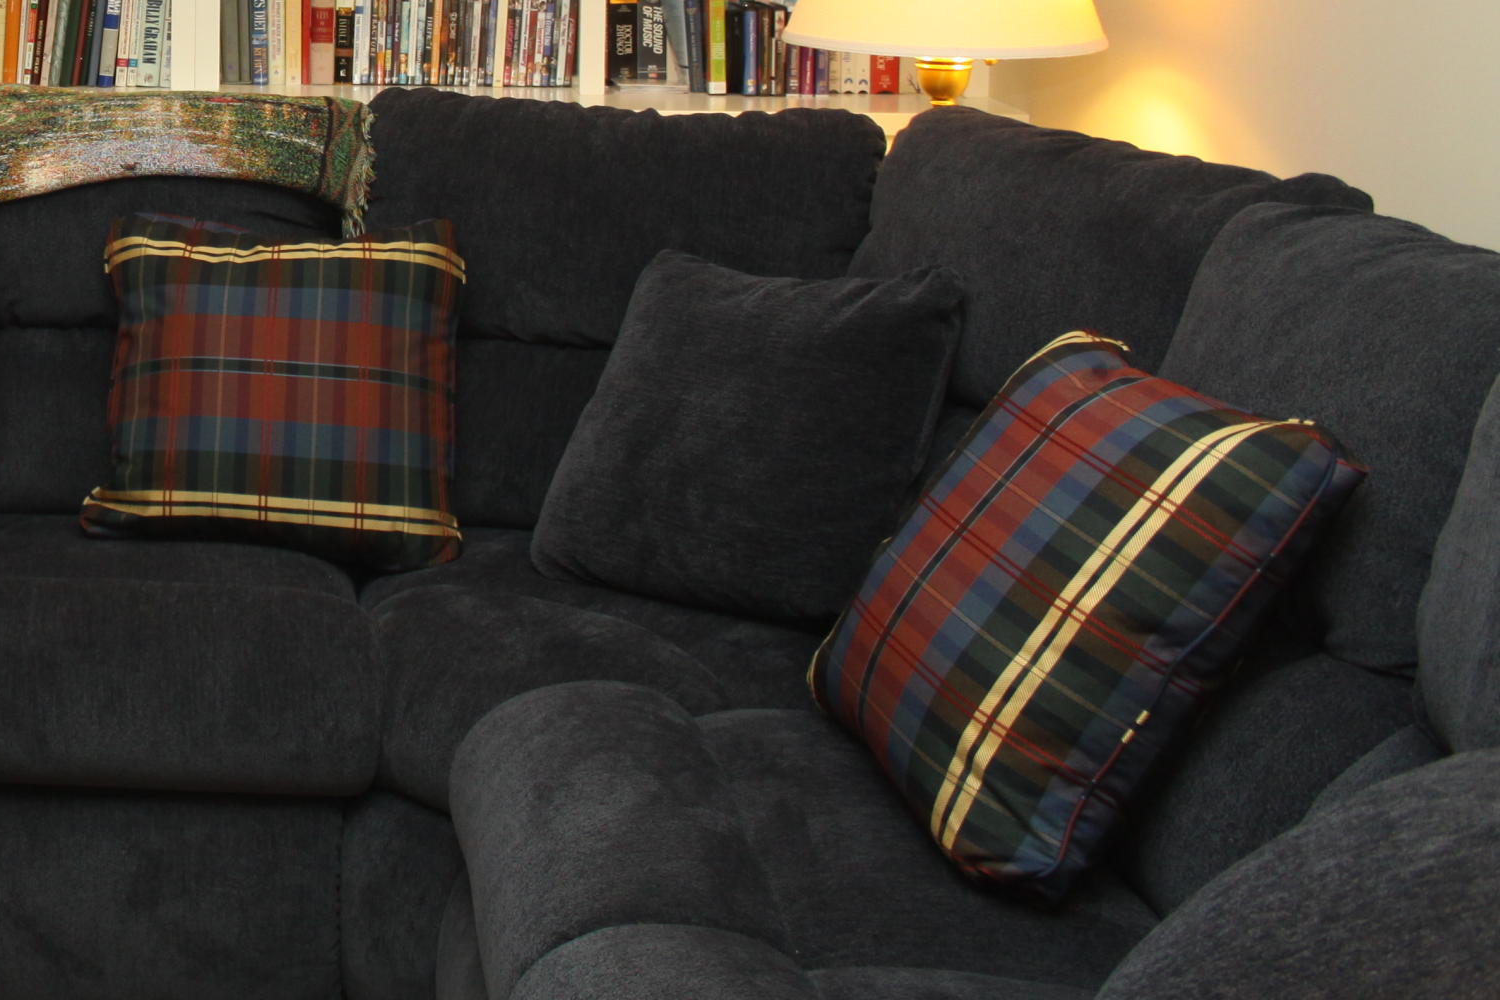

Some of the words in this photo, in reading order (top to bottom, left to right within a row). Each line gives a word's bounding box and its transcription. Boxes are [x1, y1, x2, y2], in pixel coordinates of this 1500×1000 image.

[144, 0, 164, 25] BILLY
[252, 10, 266, 32] DIET
[642, 5, 653, 18] OF
[652, 5, 664, 22] THE
[142, 26, 160, 65] GRAHAM
[624, 24, 634, 54] DOCTOR
[642, 17, 653, 48] MUSIC
[652, 23, 664, 55] SOUND
